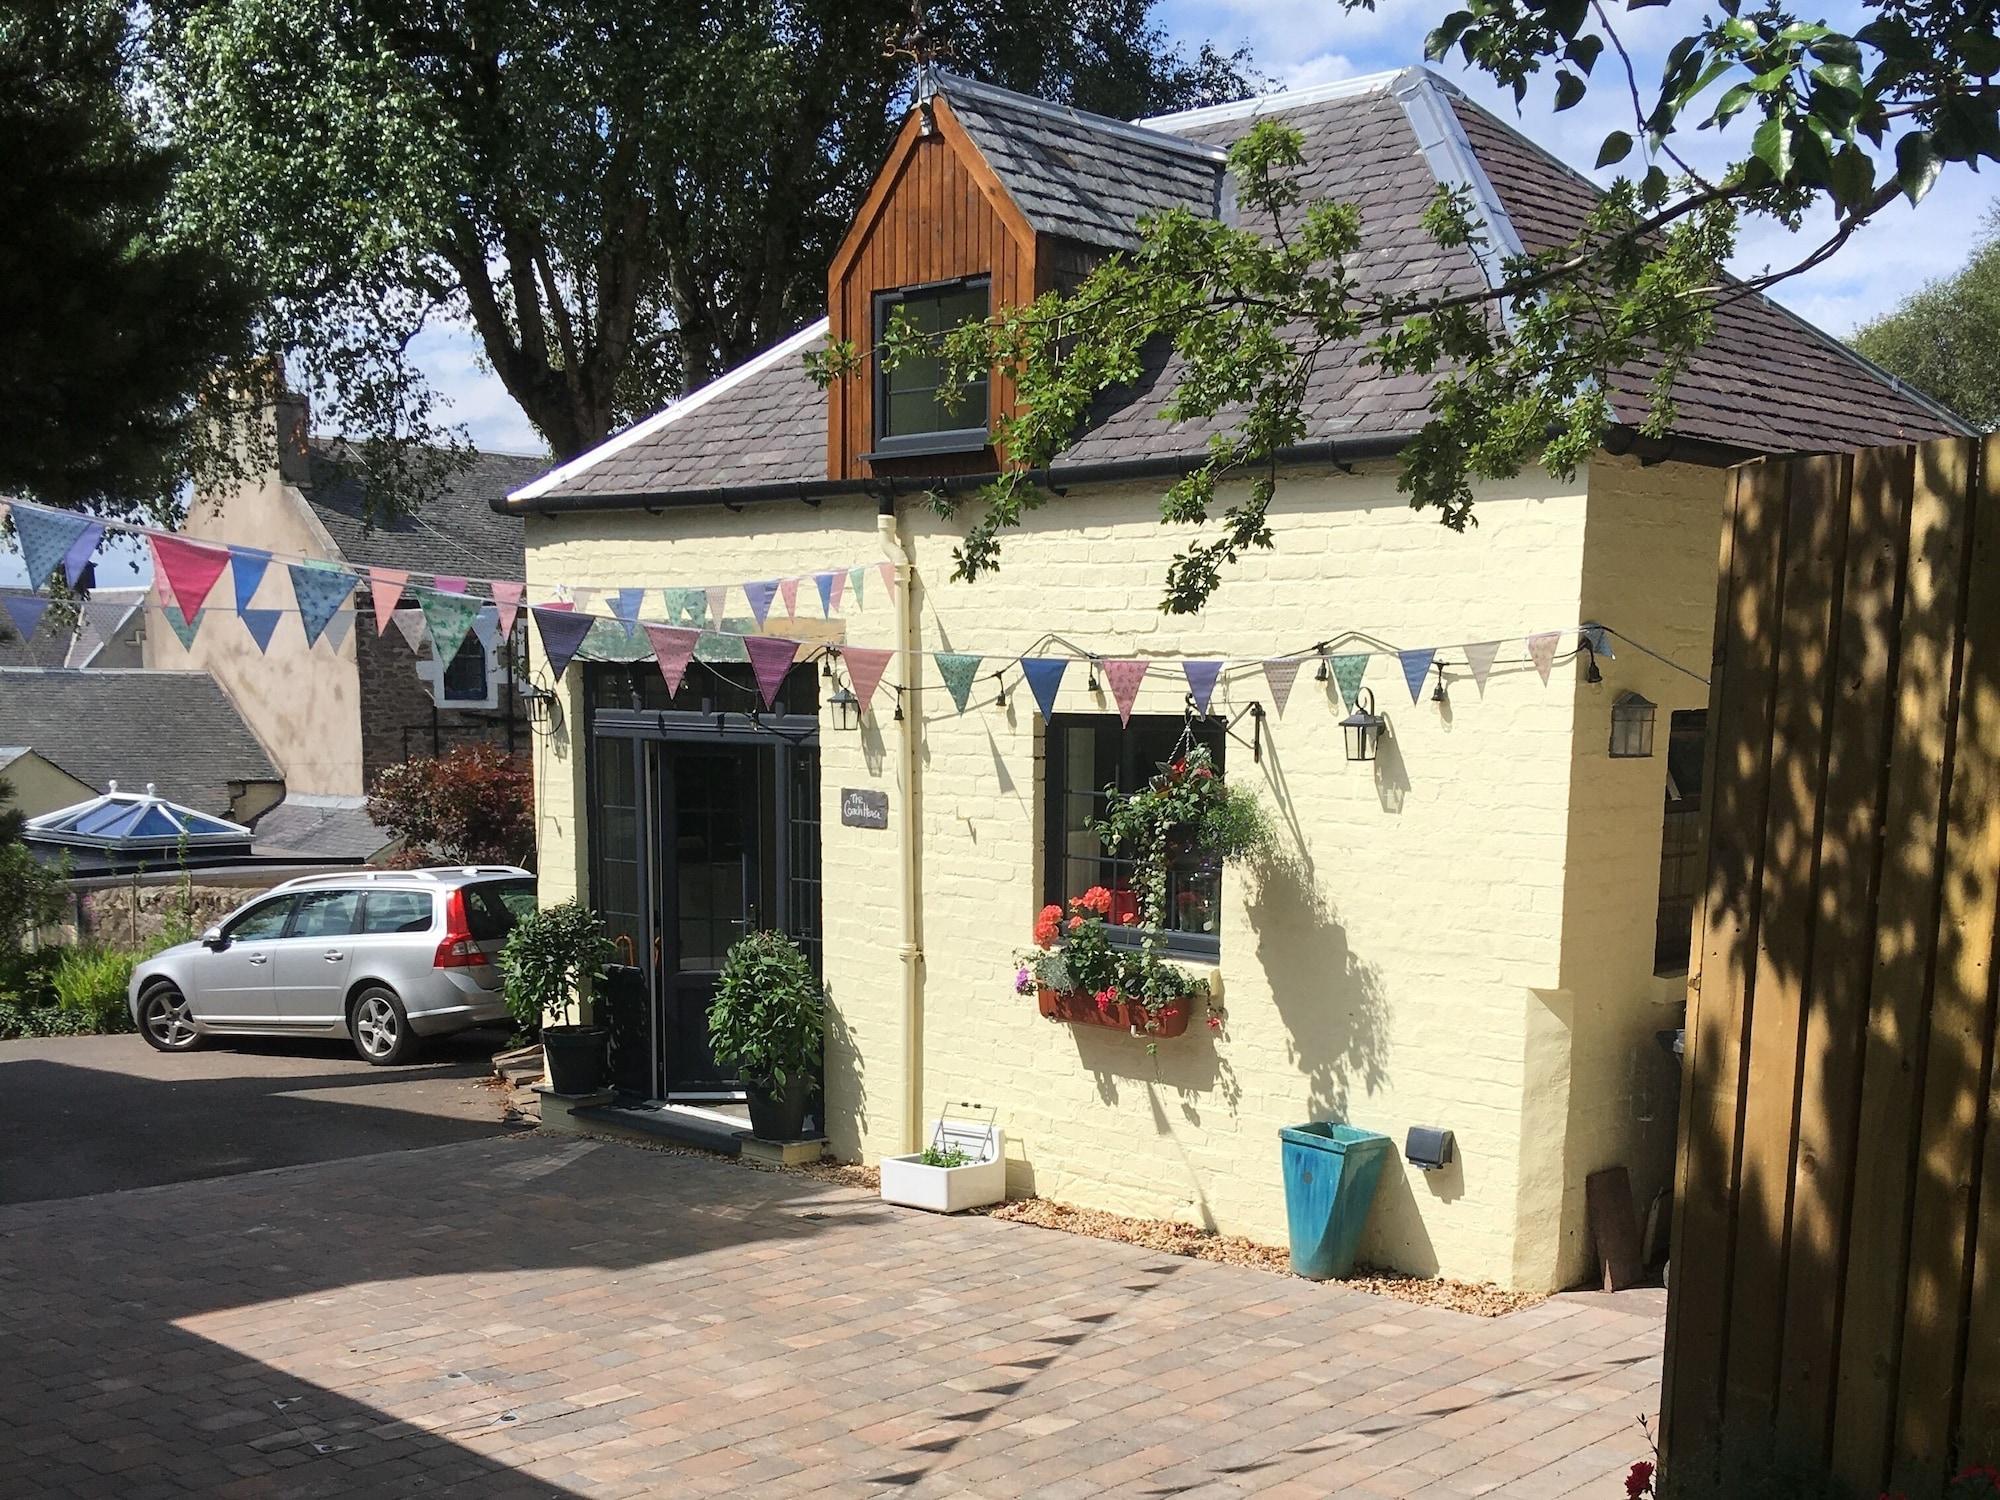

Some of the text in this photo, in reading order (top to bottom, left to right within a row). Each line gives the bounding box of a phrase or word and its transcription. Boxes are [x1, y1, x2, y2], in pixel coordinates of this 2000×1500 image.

[850, 793, 863, 804] The
[844, 800, 881, 819] Coach House
